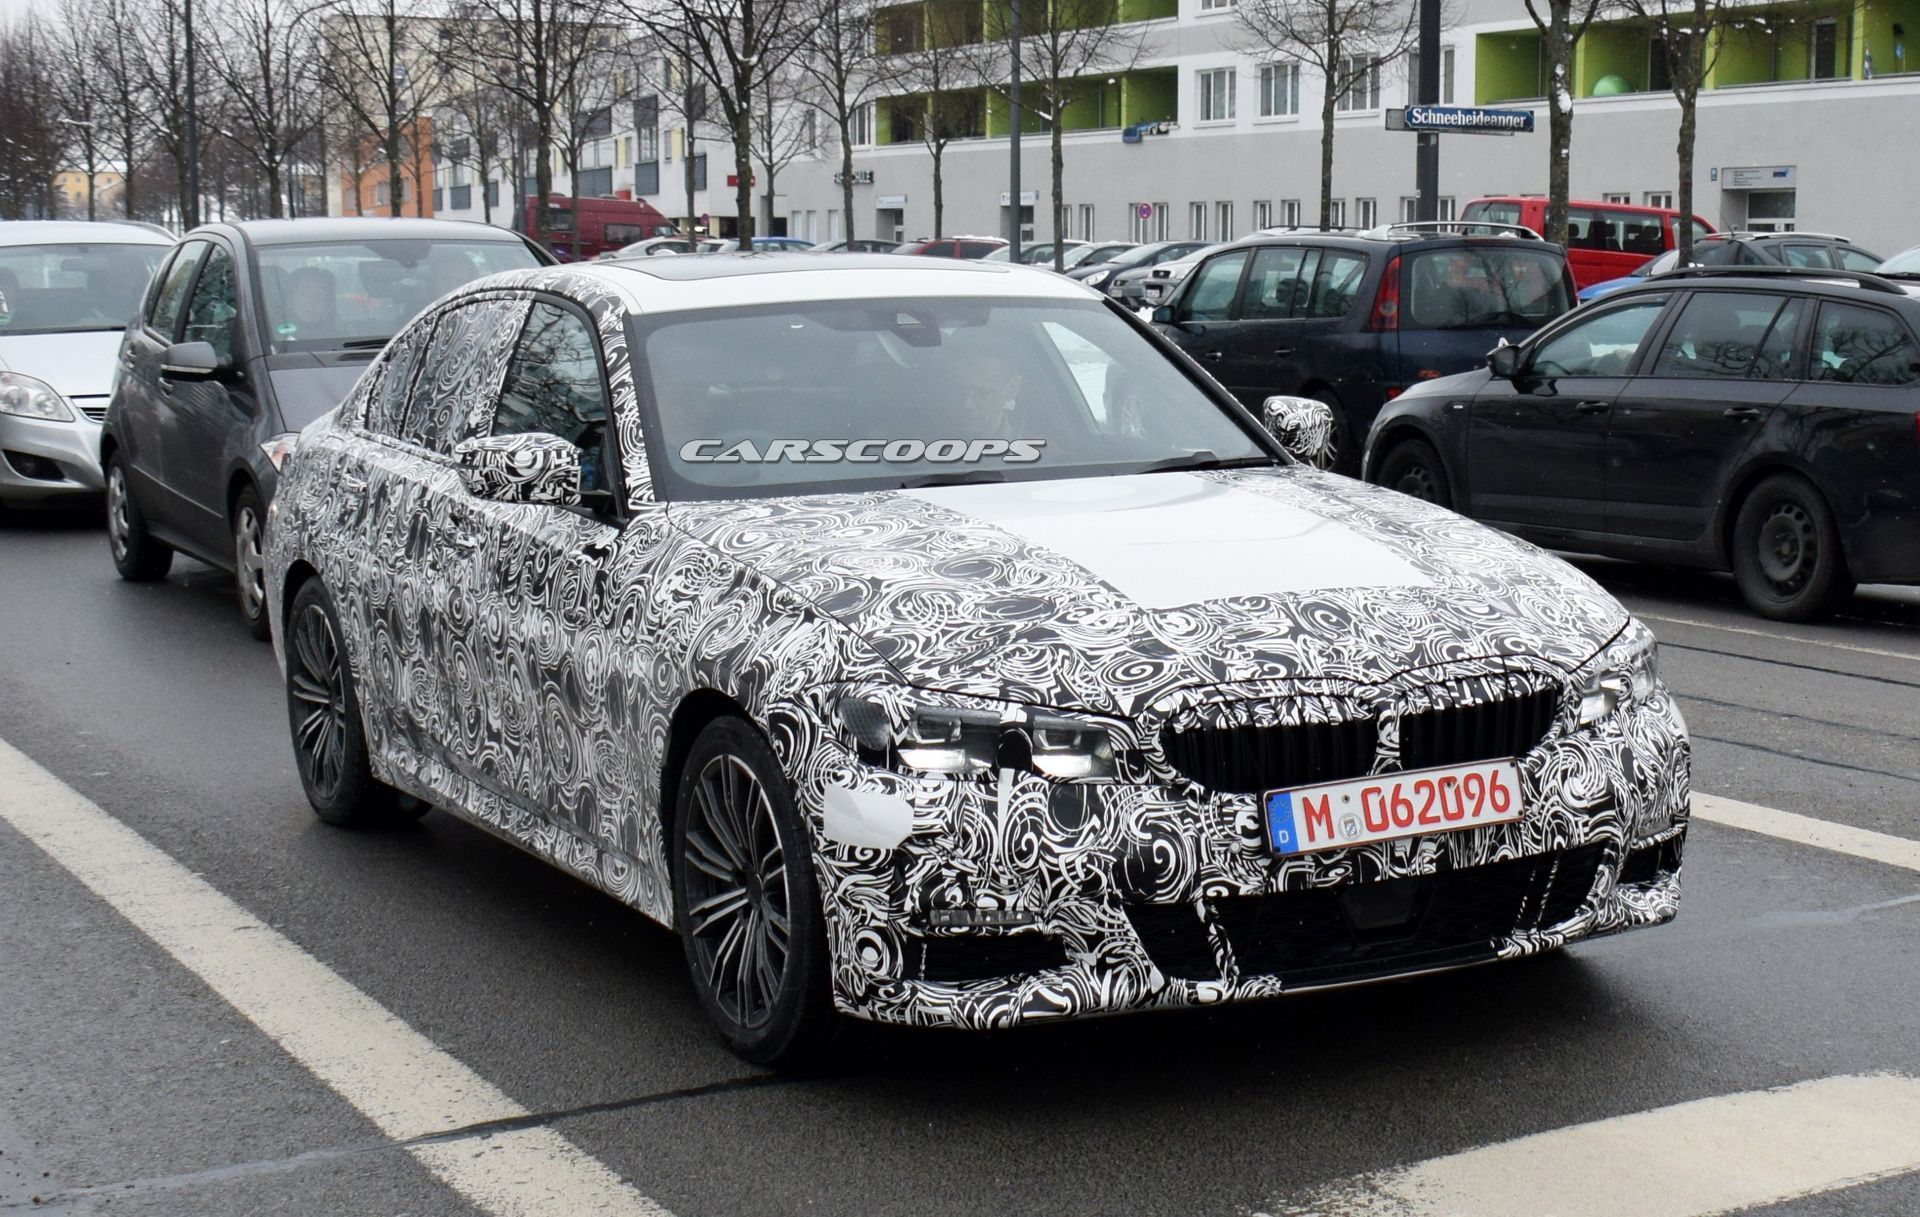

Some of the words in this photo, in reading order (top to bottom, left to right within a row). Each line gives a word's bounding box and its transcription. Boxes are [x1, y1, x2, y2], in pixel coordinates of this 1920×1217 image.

[1412, 108, 1527, 128] Schneeheideanger
[1302, 794, 1335, 842] M
[1361, 769, 1511, 833] 062096
[1279, 830, 1289, 844] D
